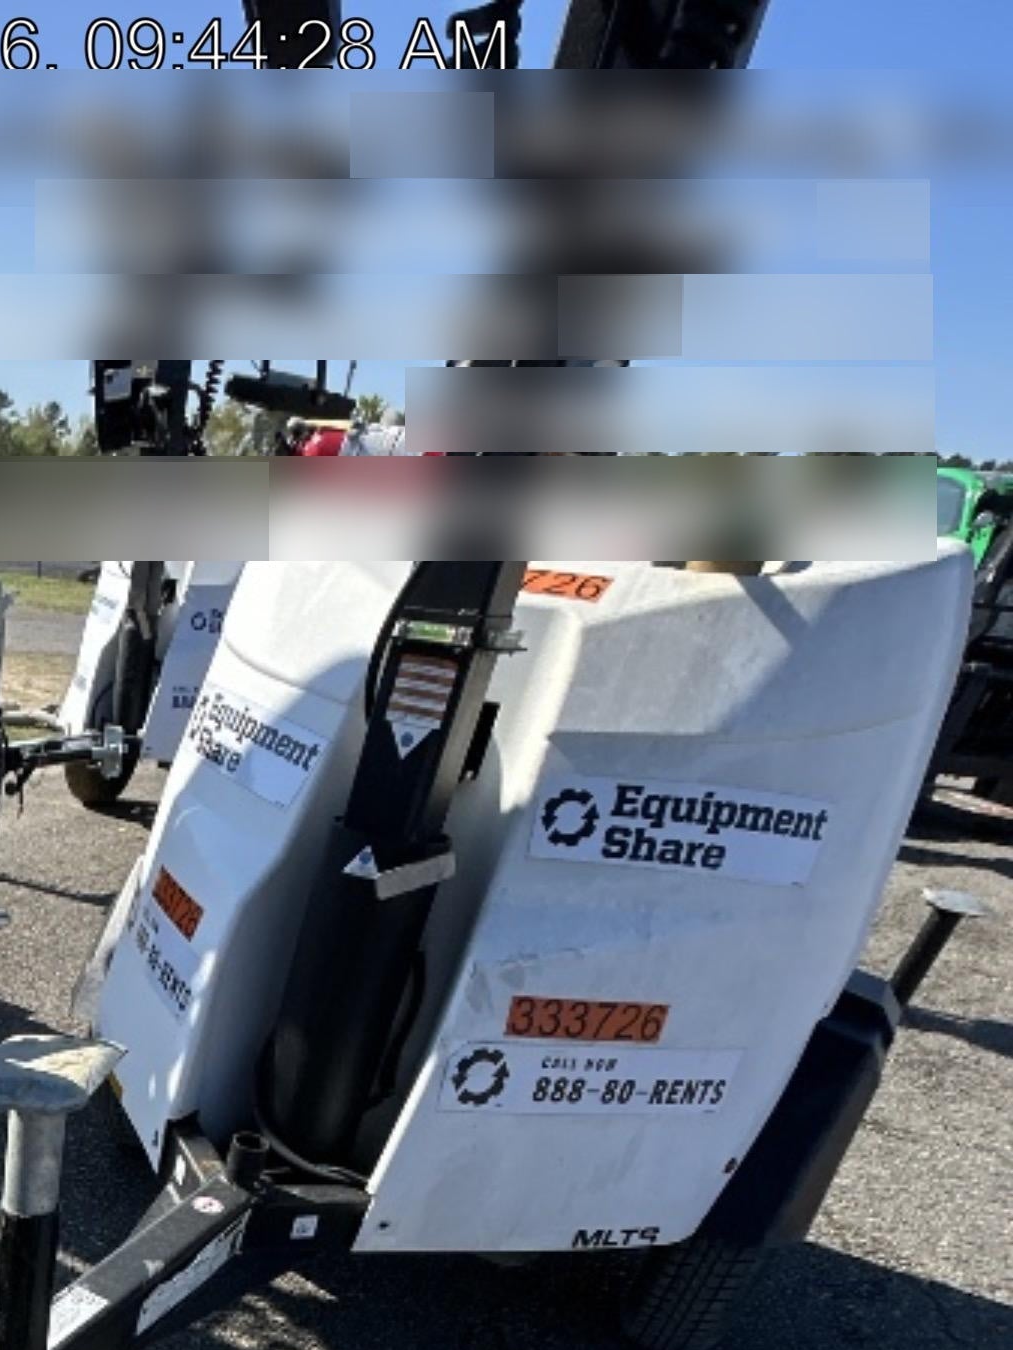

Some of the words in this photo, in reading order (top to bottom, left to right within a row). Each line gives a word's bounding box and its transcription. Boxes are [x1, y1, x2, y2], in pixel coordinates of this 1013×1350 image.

[610, 783, 828, 841] Equipment
[601, 824, 727, 870] Share
[510, 998, 669, 1042] 333726
[532, 1076, 728, 1106] 888-80-RENTS
[571, 1226, 660, 1249] MLTS
